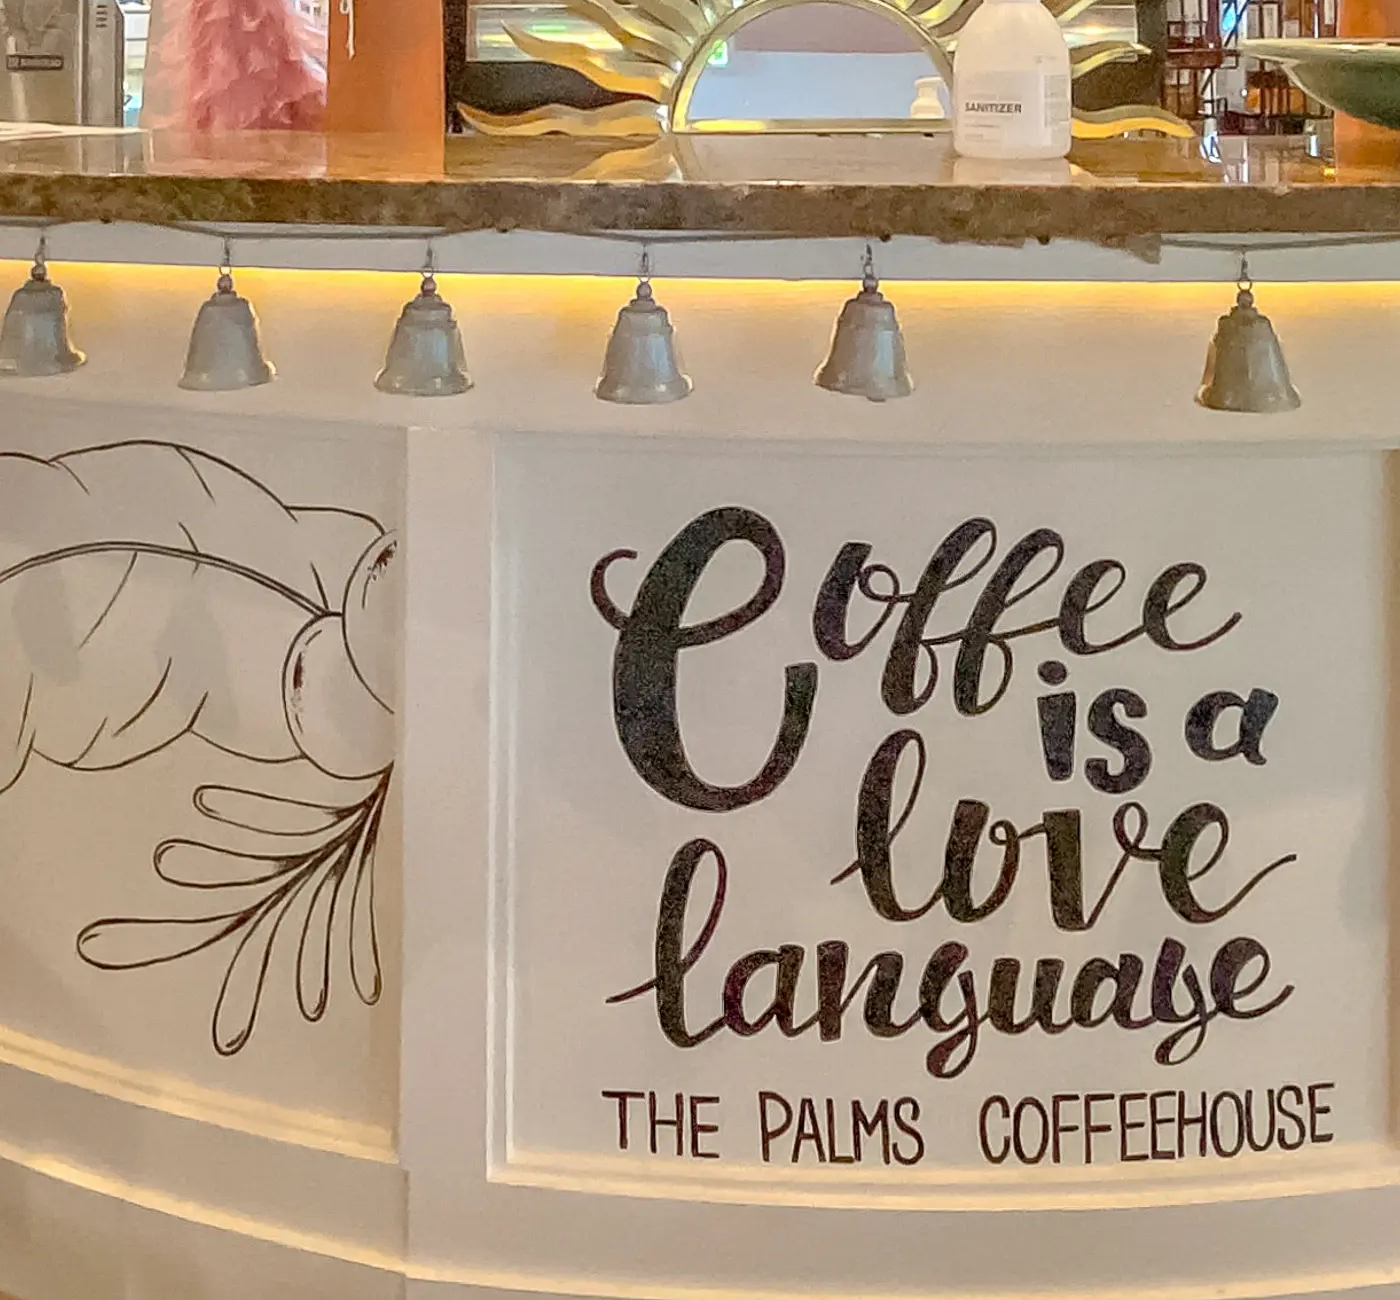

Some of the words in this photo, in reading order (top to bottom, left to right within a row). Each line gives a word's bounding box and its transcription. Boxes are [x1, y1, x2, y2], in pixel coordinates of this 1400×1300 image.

[964, 102, 1022, 114] SANITIZER
[590, 506, 1242, 813] Coffee
[1036, 660, 1152, 795] is
[1184, 688, 1279, 766] a
[830, 729, 1297, 932] love
[605, 838, 1295, 1079] language
[602, 1090, 720, 1160] THE
[759, 1091, 925, 1165] PALMS
[979, 1082, 1336, 1166] COFFEEHOUSE
